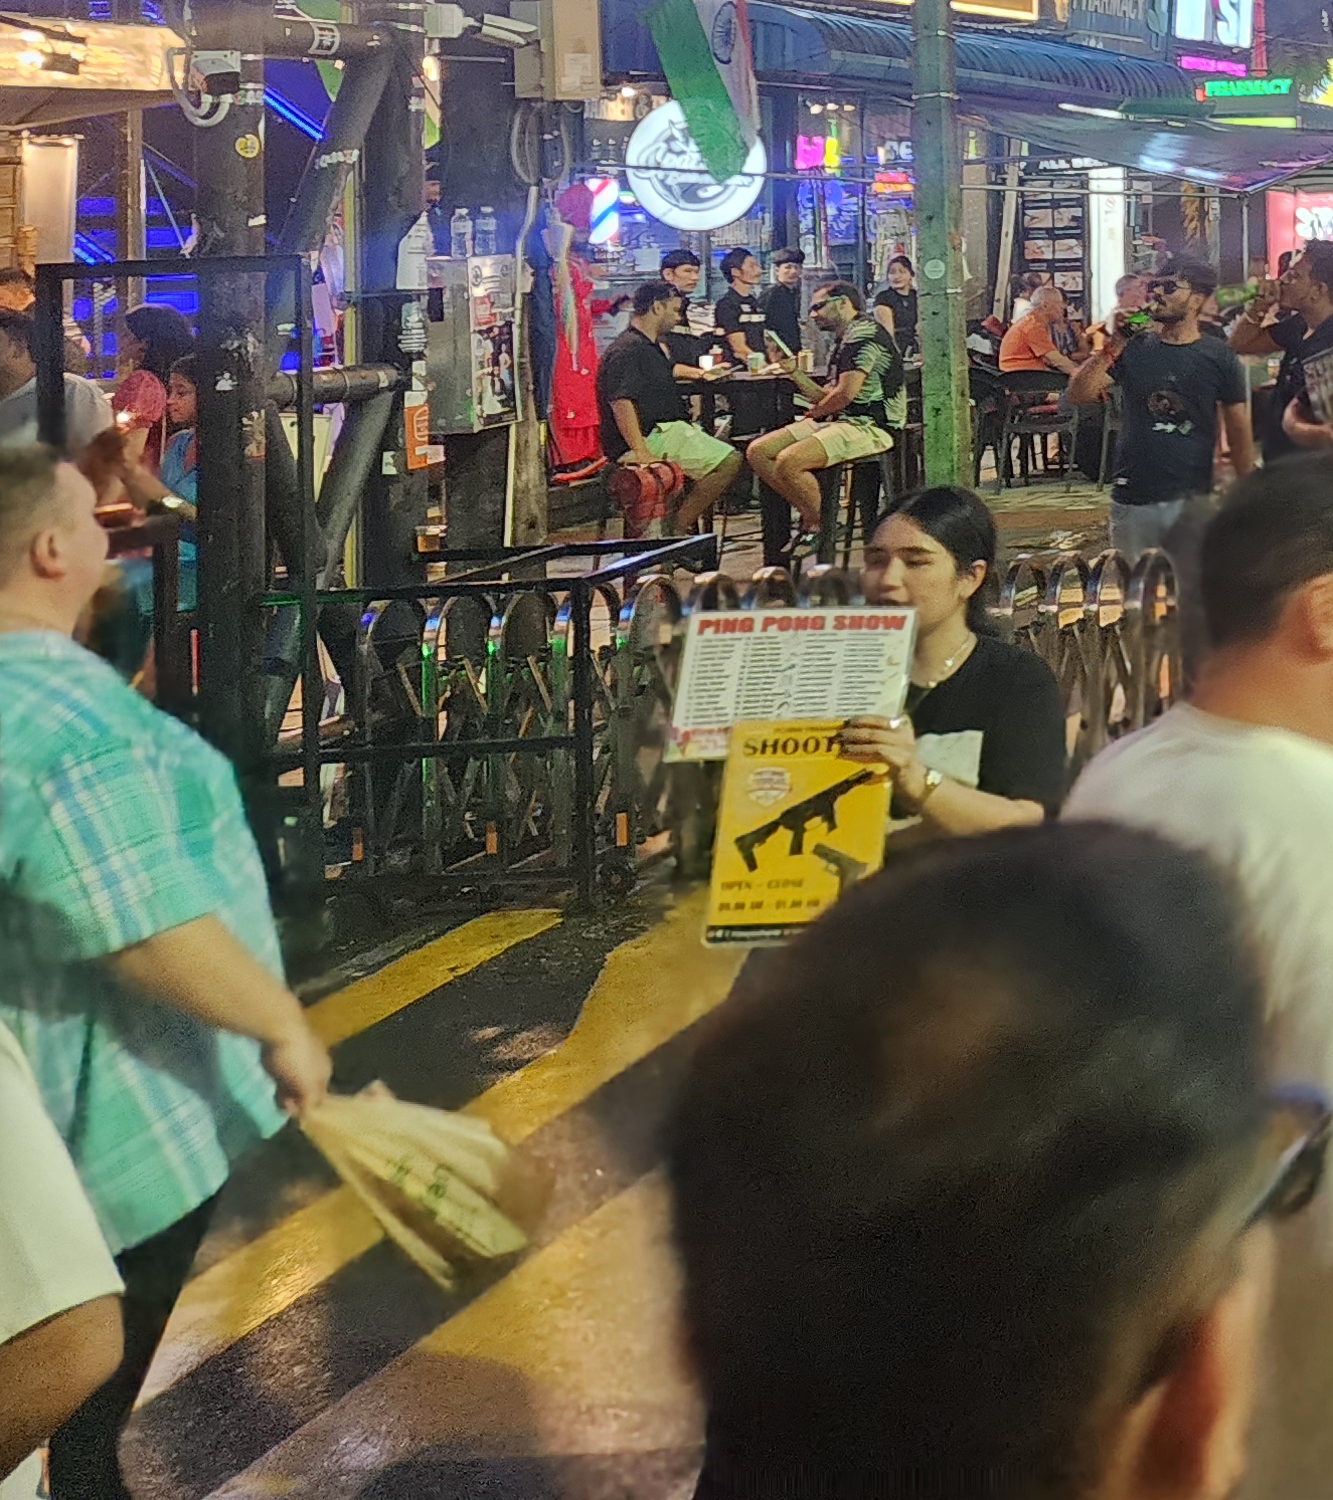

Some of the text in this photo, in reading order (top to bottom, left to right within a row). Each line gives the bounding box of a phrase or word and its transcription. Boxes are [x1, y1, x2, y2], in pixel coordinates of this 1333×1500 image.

[697, 614, 908, 636] PING PONG SHOW
